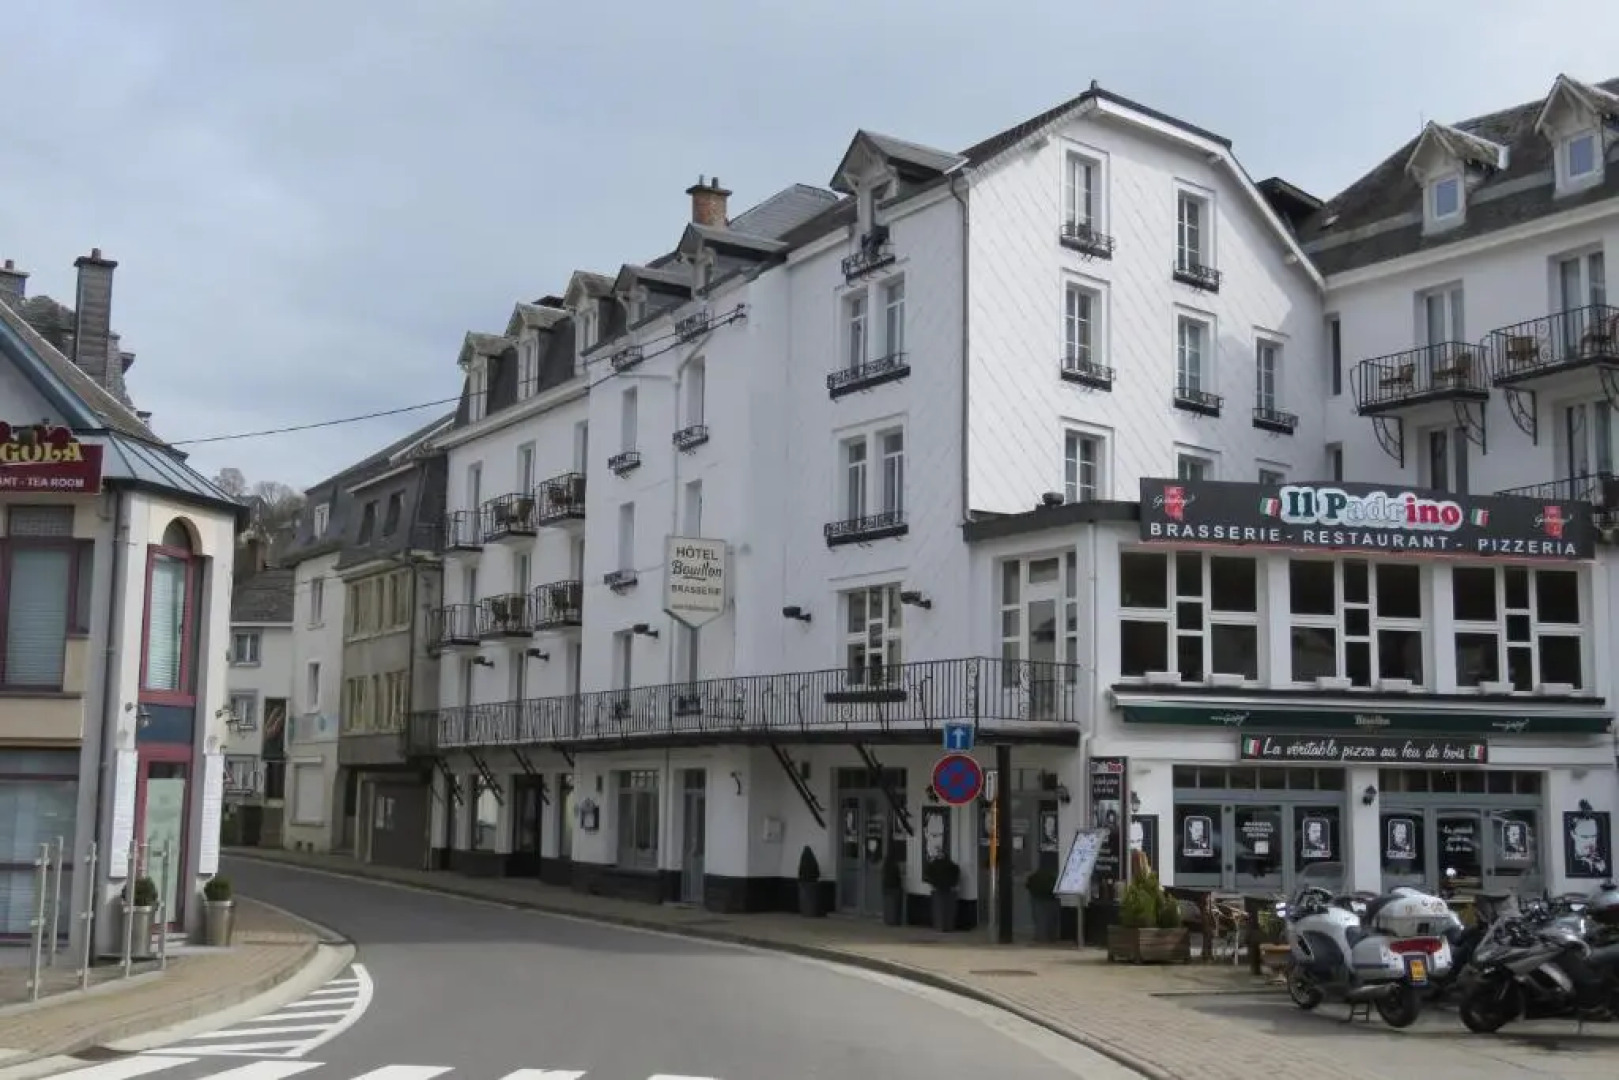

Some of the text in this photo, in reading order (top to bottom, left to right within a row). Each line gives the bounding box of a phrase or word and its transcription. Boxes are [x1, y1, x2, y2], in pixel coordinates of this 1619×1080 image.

[28, 477, 48, 488] TEA
[51, 478, 84, 488] ROOM
[1288, 491, 1461, 525] Il Padrino
[1150, 522, 1280, 542] BRASSERIE
[1303, 530, 1449, 549] RESTAURANT
[1478, 538, 1577, 555] PIZZERIA
[676, 545, 719, 560] HÔTEL
[671, 585, 722, 596] BRASSERIE
[1263, 737, 1465, 761] La véritable pizza au feu de bois
